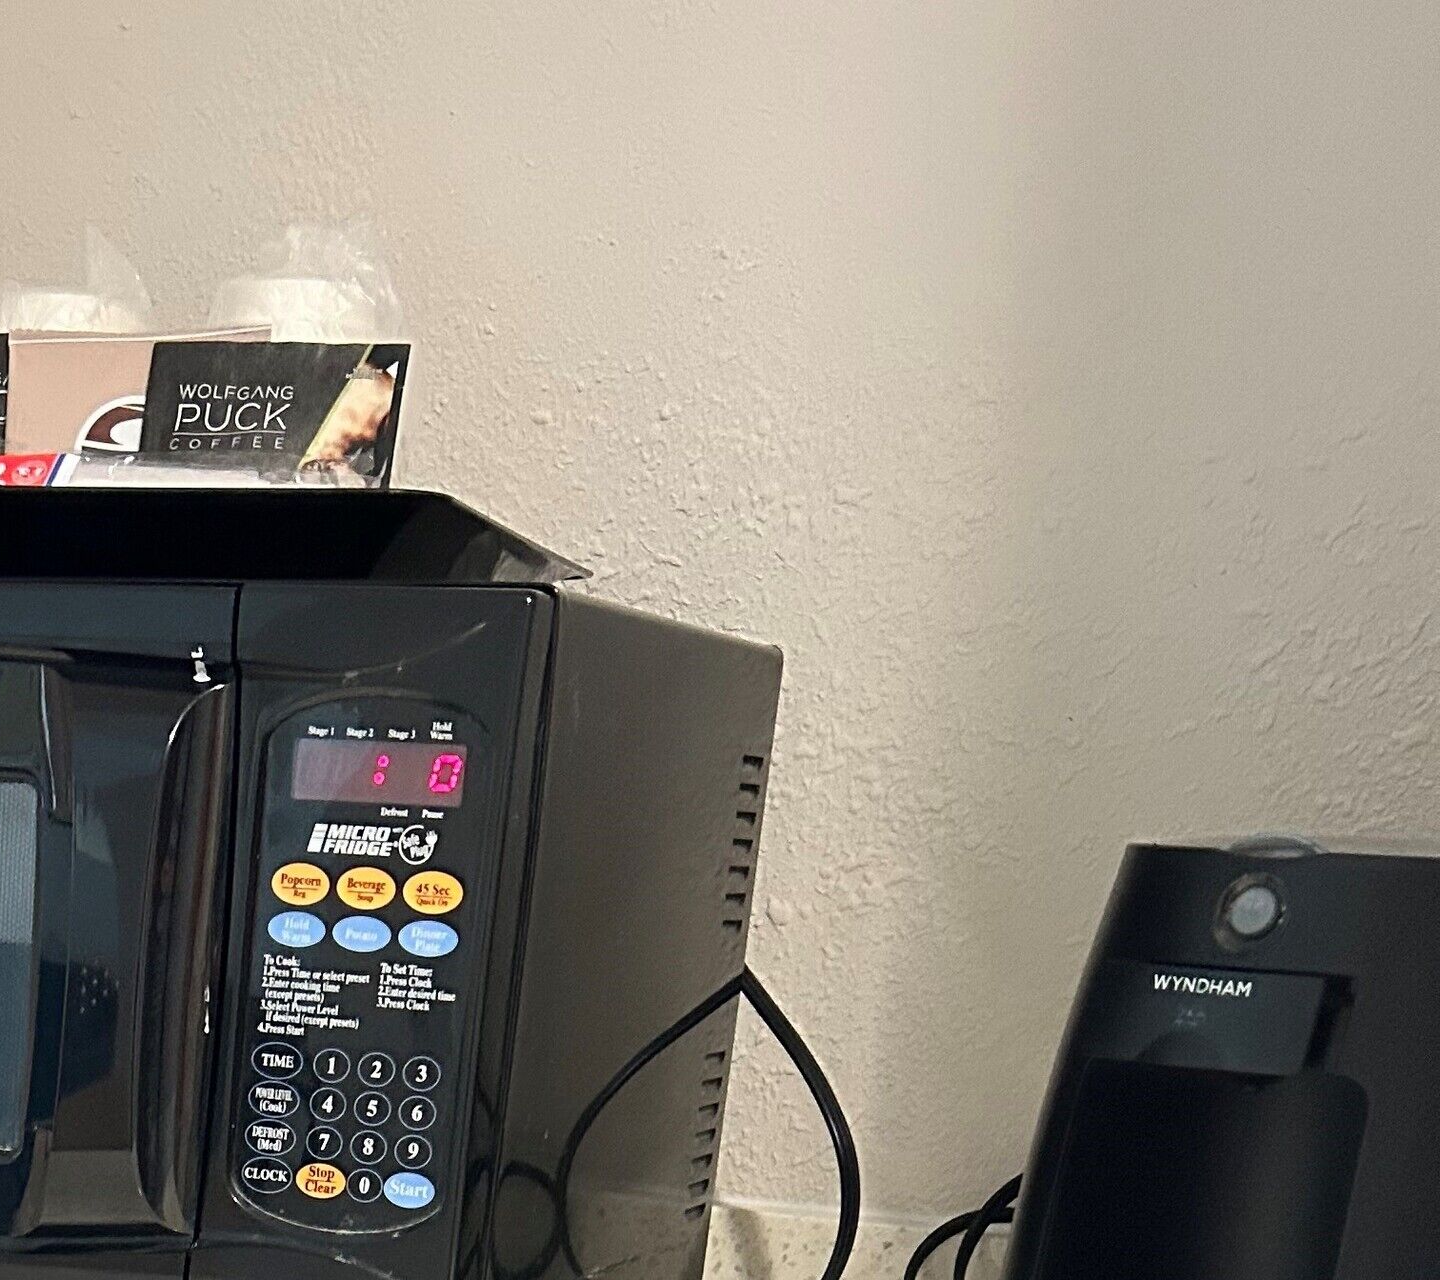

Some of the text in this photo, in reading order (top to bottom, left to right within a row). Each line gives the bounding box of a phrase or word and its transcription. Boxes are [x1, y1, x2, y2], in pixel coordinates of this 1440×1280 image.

[179, 383, 294, 400] WOLFGANG
[174, 402, 291, 432] PUCK
[169, 436, 285, 451] COFFEE
[308, 725, 330, 737] Stage
[346, 727, 367, 739] Stage
[388, 729, 409, 740] Stage
[327, 824, 391, 842] MICRO
[323, 839, 393, 857] FRIDGE
[281, 873, 321, 889] Popcorn
[347, 878, 386, 893] Beverage
[416, 883, 450, 896] 45 Sec
[263, 954, 274, 965] To
[380, 962, 391, 974] To
[392, 963, 407, 975] Set
[1153, 973, 1253, 998] WYNDHAM
[261, 1053, 294, 1069] TIME
[327, 1056, 336, 1074] 1
[370, 1060, 382, 1079] 2
[415, 1064, 428, 1083] 3
[259, 1099, 287, 1113] (Cook)
[321, 1094, 334, 1113] 4
[366, 1099, 378, 1117] 5
[411, 1104, 423, 1122] 6
[252, 1125, 289, 1141] DEFROST
[257, 1138, 282, 1152] (Med)
[318, 1133, 330, 1151] 7
[362, 1137, 374, 1156] 8
[407, 1142, 419, 1160] 9
[244, 1167, 288, 1183] CLOCK
[308, 1165, 335, 1182] Stop
[305, 1180, 336, 1194] Clear
[359, 1176, 370, 1194] 0
[389, 1182, 428, 1199] Start
